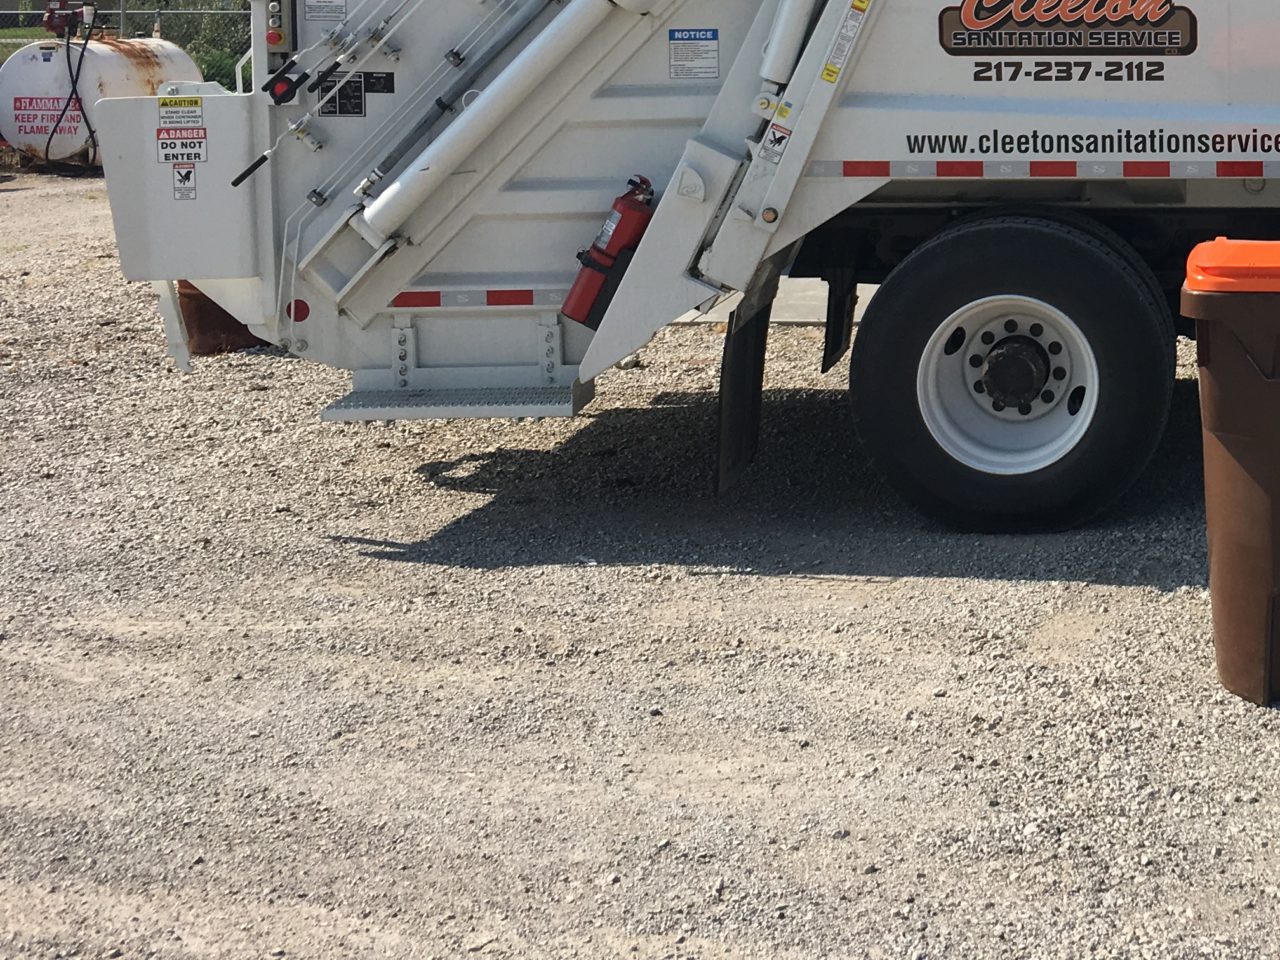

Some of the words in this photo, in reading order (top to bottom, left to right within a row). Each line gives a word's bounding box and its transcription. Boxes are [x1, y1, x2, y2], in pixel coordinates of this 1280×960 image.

[674, 31, 713, 39] NOTICE
[952, 30, 1083, 47] SANITATION
[1088, 30, 1181, 47] SERVICE
[973, 61, 1165, 82] 217-237-2112
[169, 99, 199, 107] CAUTION
[14, 114, 38, 123] KEEP
[64, 114, 81, 123] AND
[18, 125, 49, 135] FLAME
[54, 125, 79, 135] AWAY
[169, 129, 205, 138] DANGER
[160, 141, 177, 150] DO
[180, 141, 203, 149] NOT
[164, 153, 201, 161] ENTER
